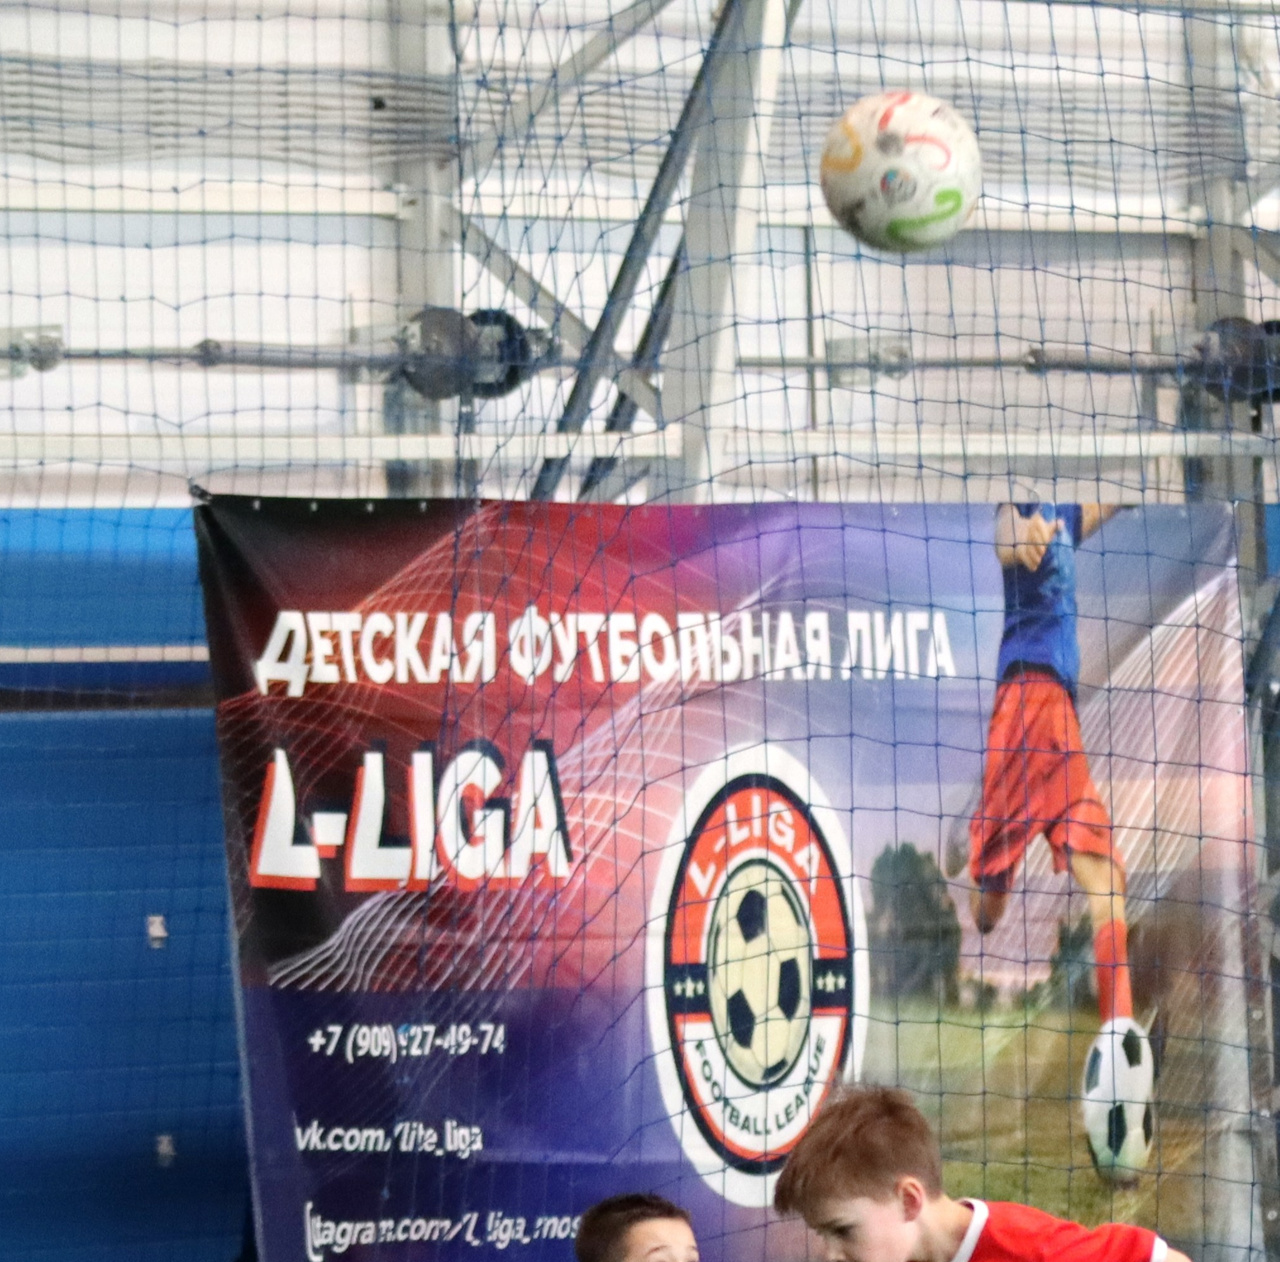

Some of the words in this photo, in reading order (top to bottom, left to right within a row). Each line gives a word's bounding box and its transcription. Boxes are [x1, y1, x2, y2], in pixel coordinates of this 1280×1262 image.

[255, 610, 496, 697] ДЕТСКАЯ
[509, 605, 830, 685] ФУТБОЛЬНАЯ
[849, 611, 957, 681] ЛИГА
[250, 744, 572, 890] L-LIGA
[688, 793, 821, 899] L-LIGA
[307, 1024, 343, 1056] +7
[694, 1039, 771, 1135] FOOTBALL
[775, 1034, 826, 1131] LEAGUE
